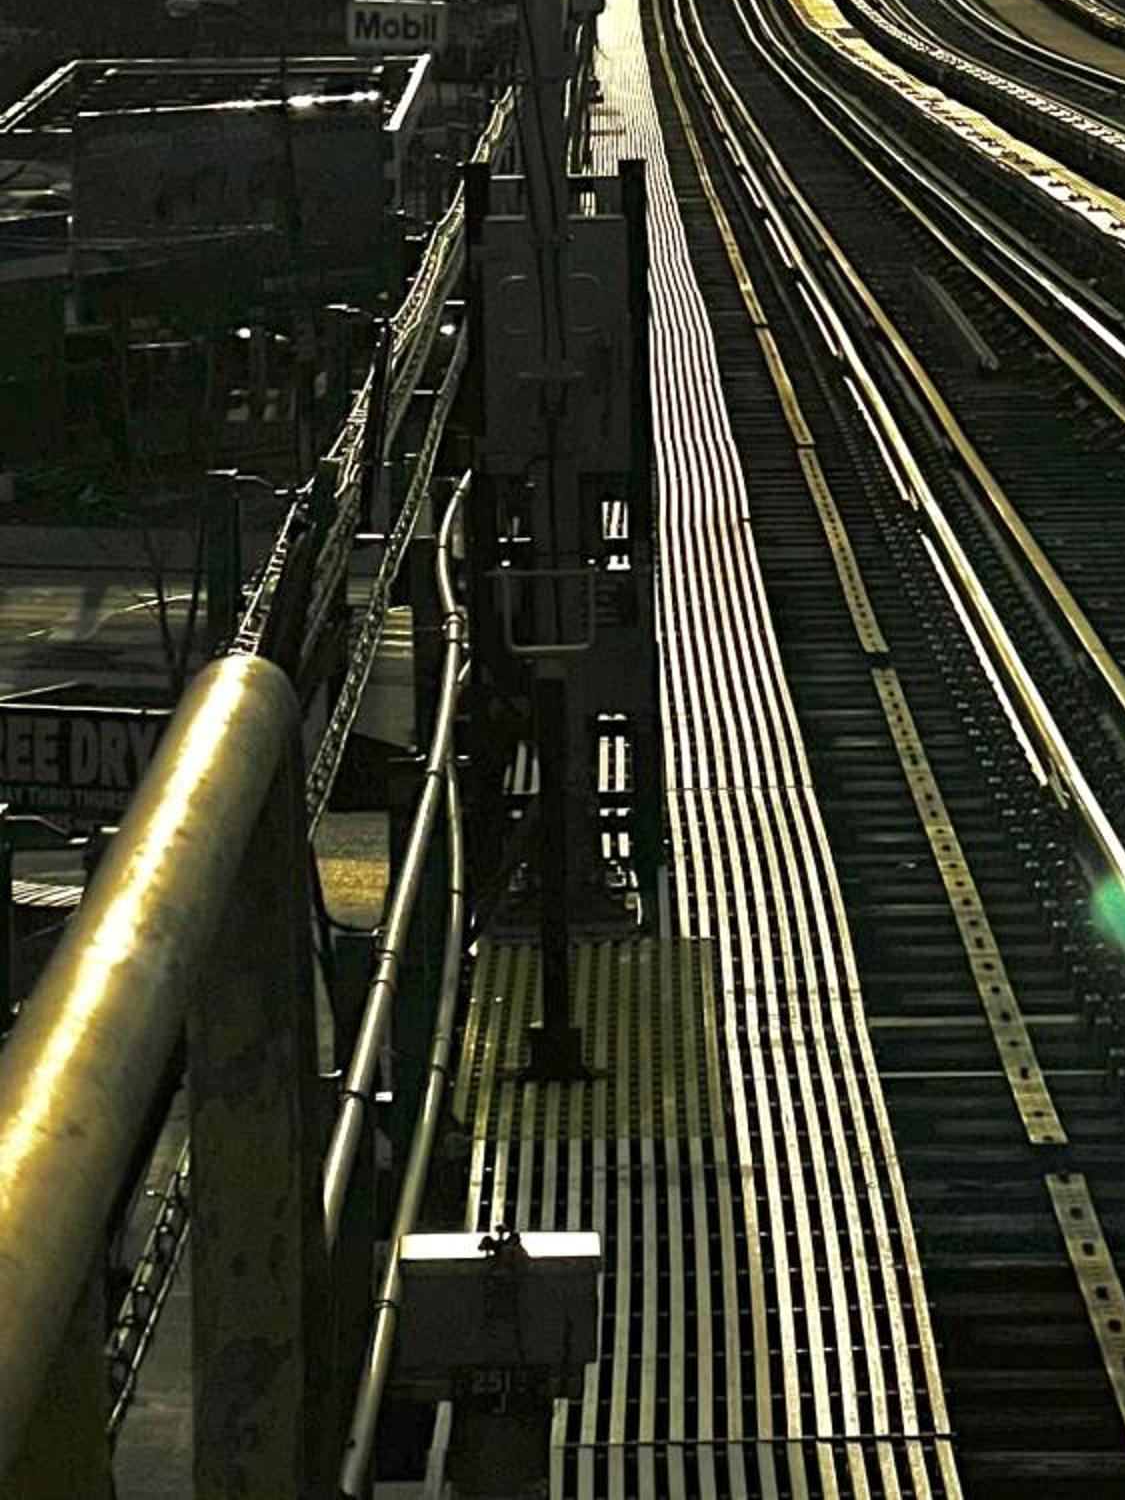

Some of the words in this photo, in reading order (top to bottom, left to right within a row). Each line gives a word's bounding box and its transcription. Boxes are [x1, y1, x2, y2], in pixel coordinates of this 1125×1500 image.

[356, 11, 437, 40] Mobil
[0, 714, 57, 781] EE
[70, 718, 157, 787] DRY
